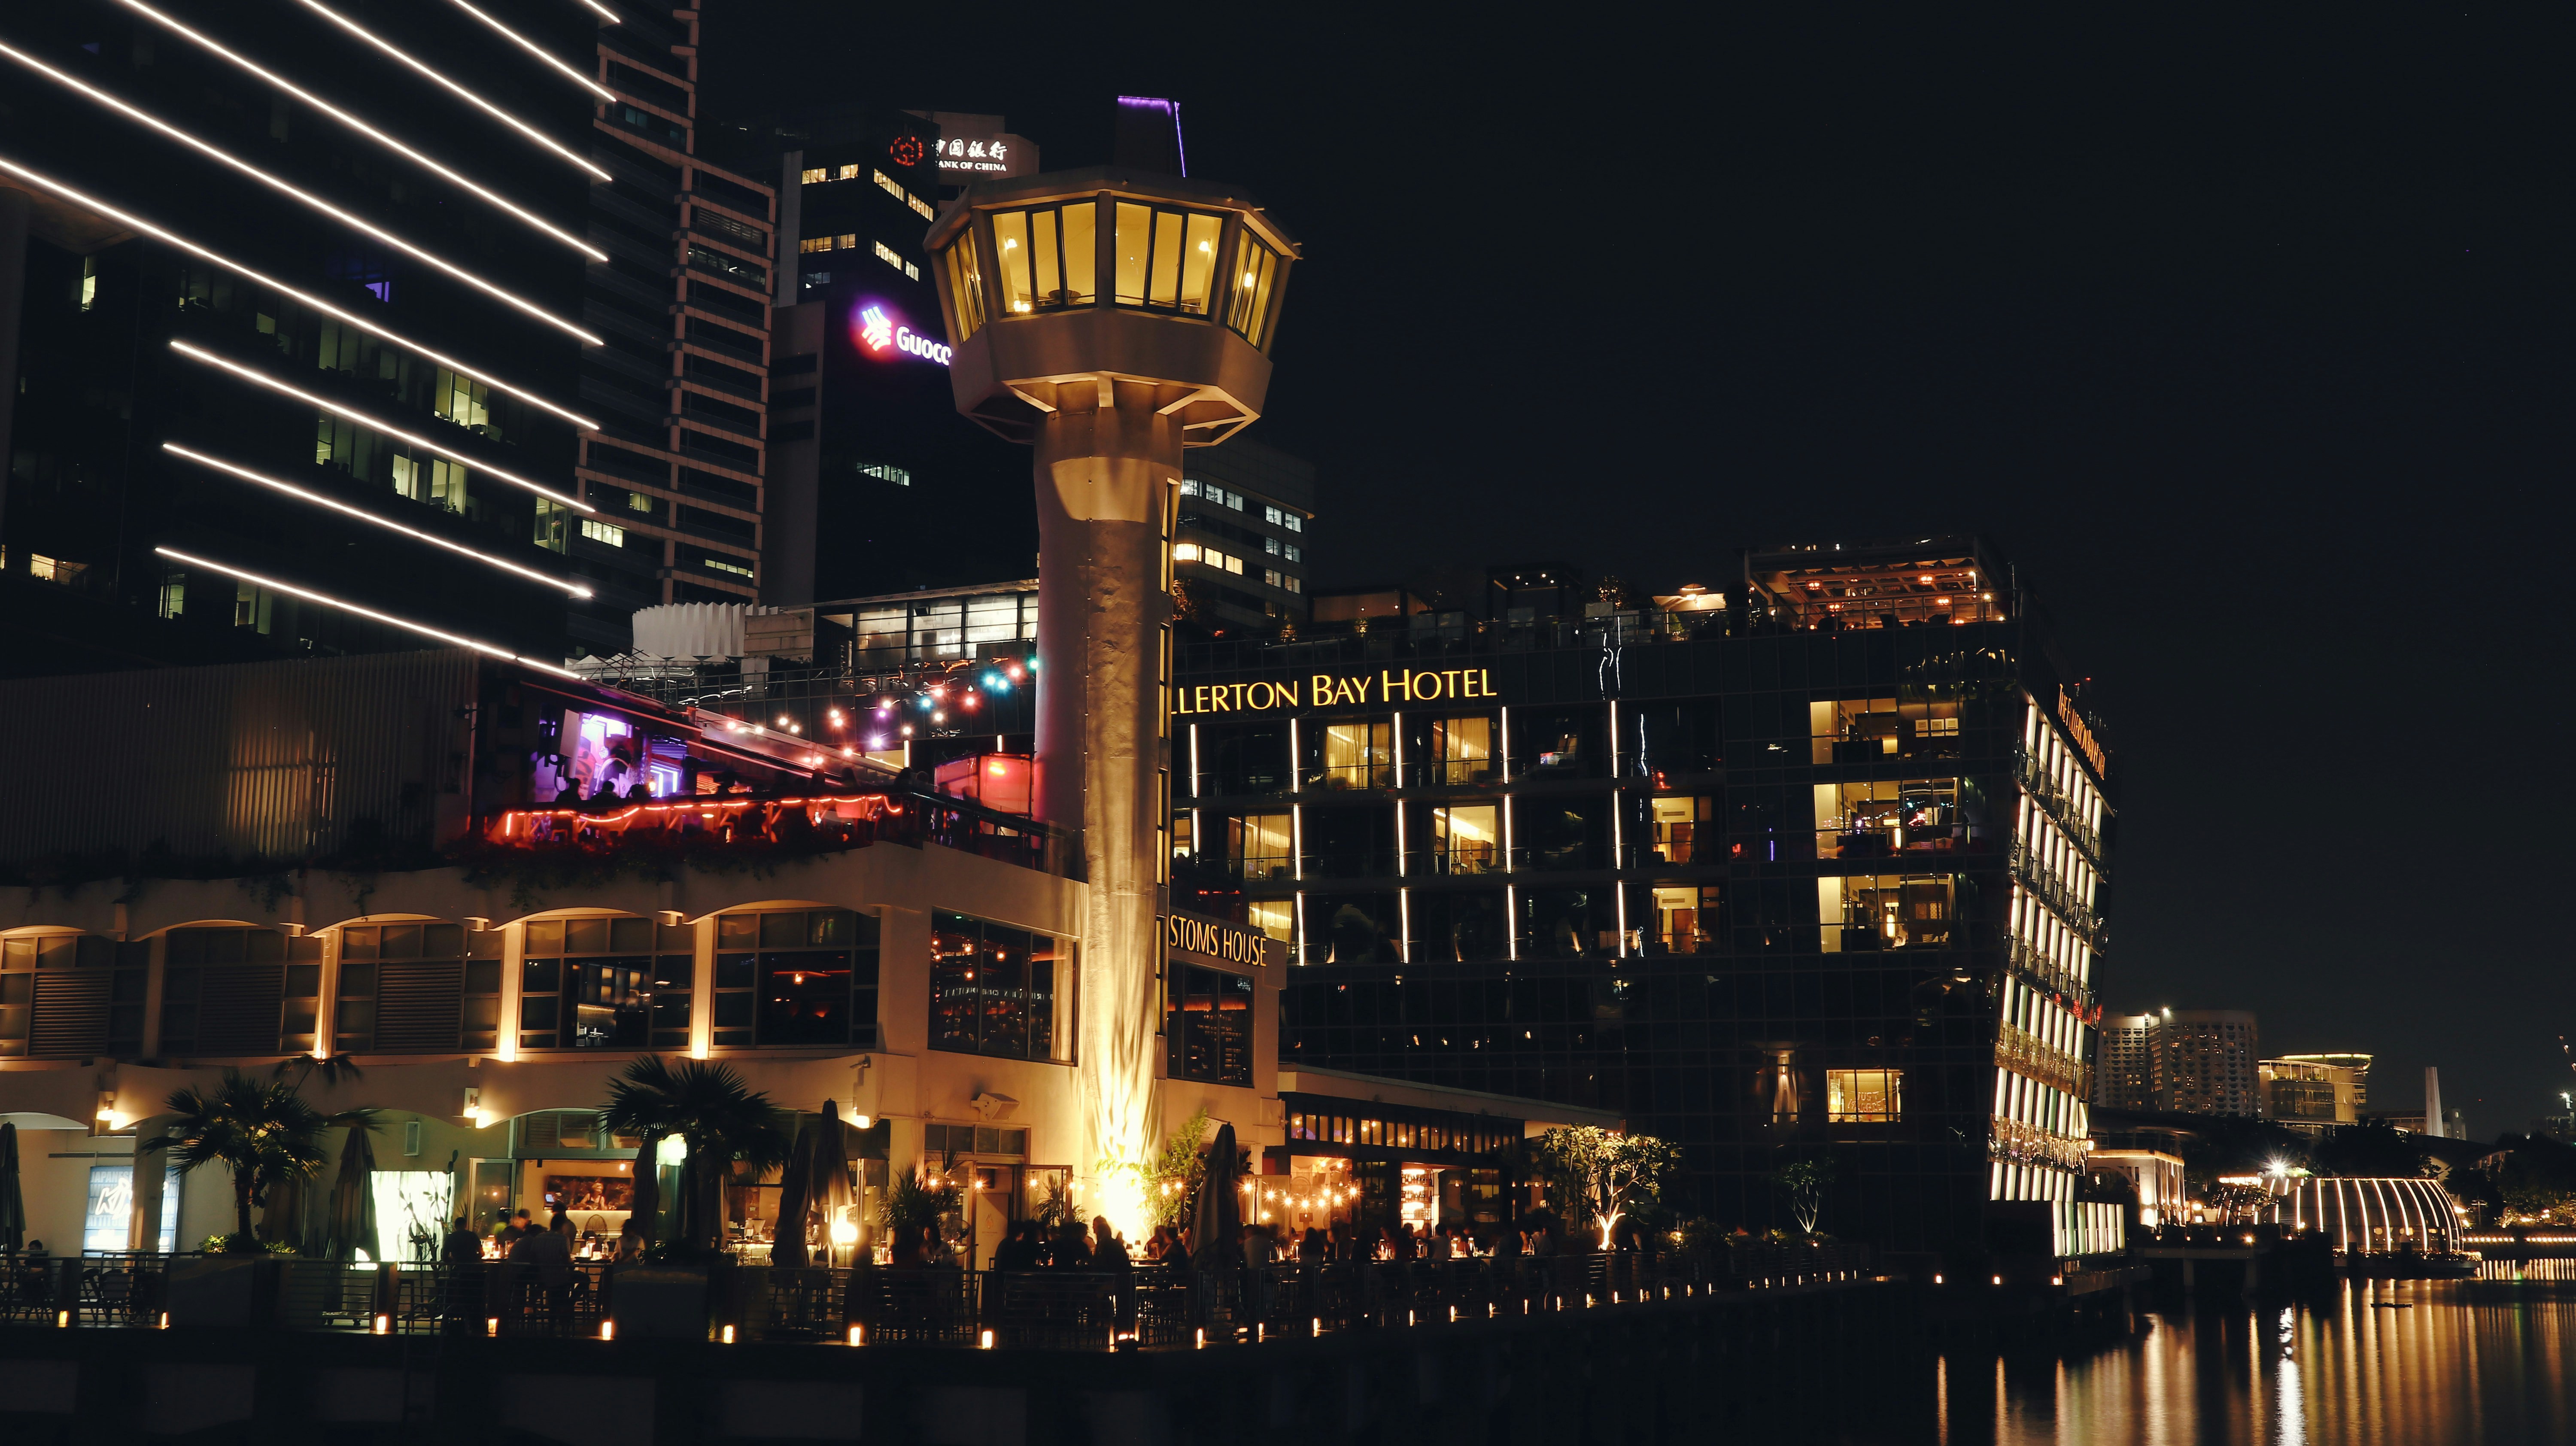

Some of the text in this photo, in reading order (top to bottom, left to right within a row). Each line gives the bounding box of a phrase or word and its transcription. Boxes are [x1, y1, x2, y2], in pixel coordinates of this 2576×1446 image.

[936, 160, 1007, 172] ANK OF CHINA
[1171, 680, 1298, 714] LERTON
[1223, 928, 1267, 967] HOUSE
